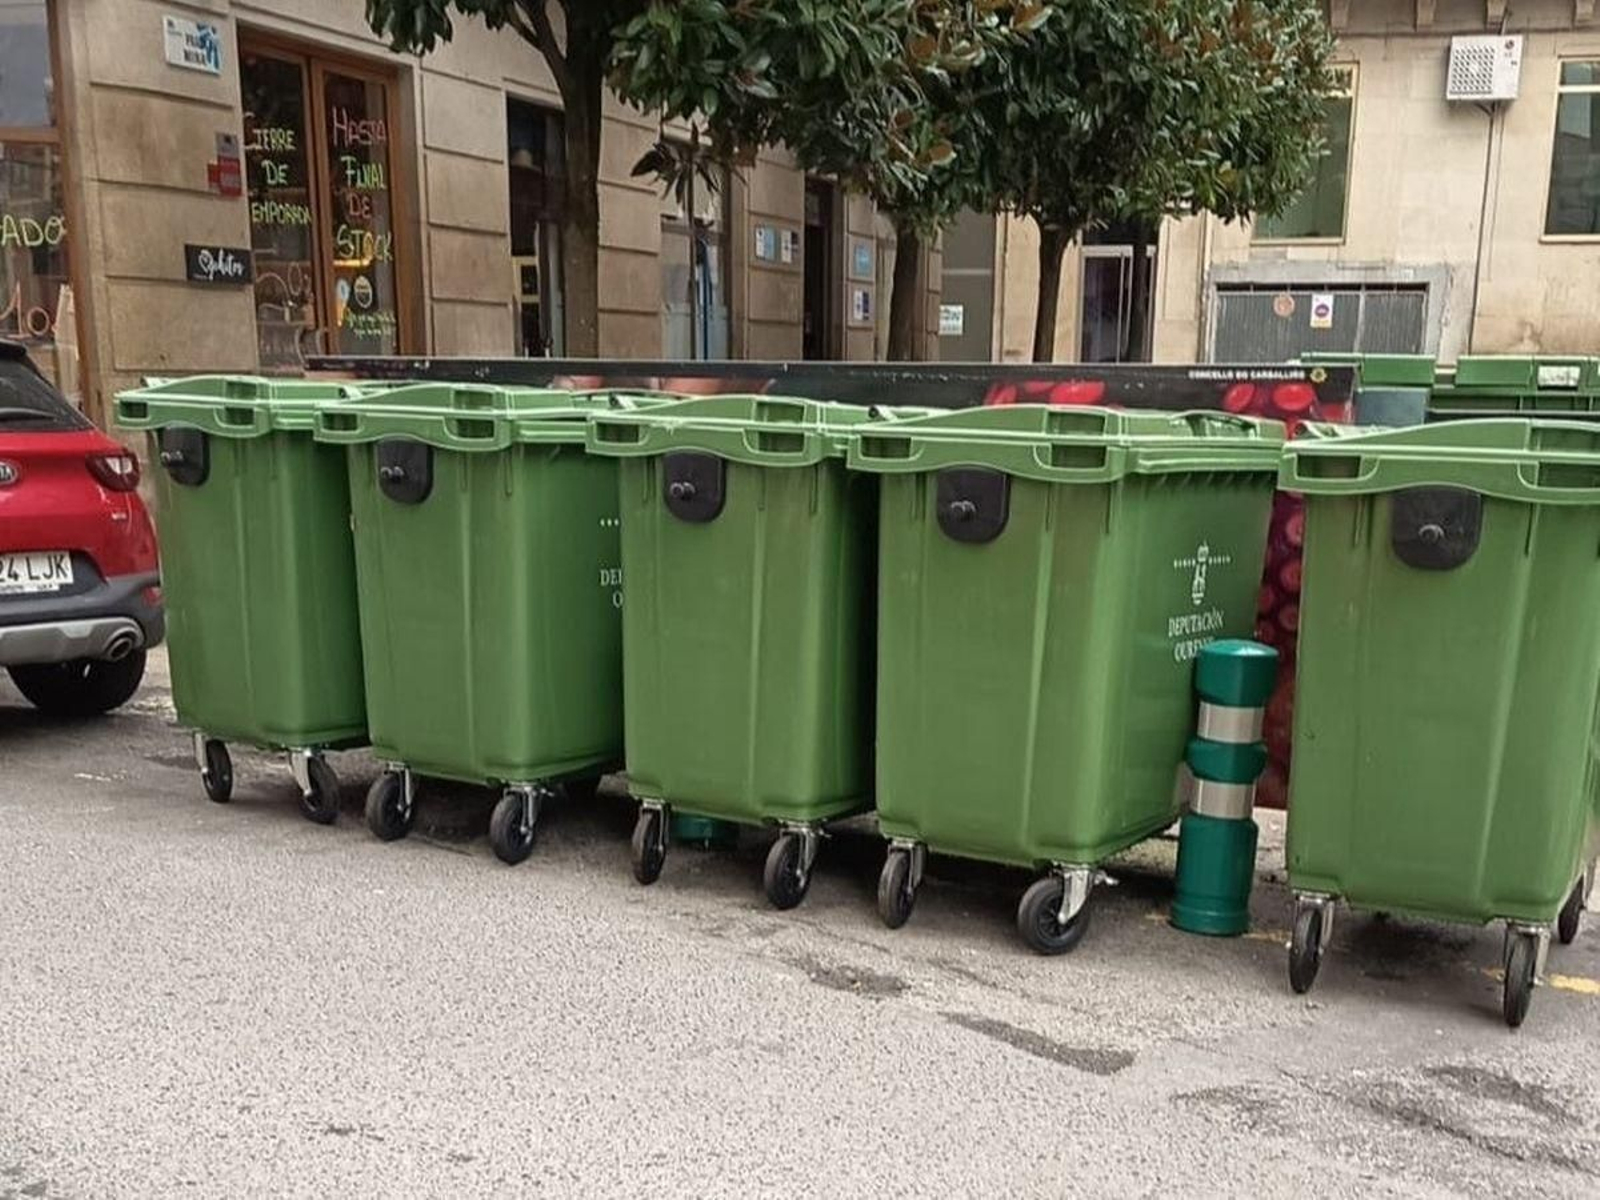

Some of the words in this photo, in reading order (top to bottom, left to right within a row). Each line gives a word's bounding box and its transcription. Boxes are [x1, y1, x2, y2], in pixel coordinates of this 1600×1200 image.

[261, 159, 289, 186] DE
[348, 190, 372, 219] DE
[336, 223, 394, 264] STOCK
[25, 554, 69, 581] LJK
[1168, 606, 1225, 638] DEPUTACIÓN
